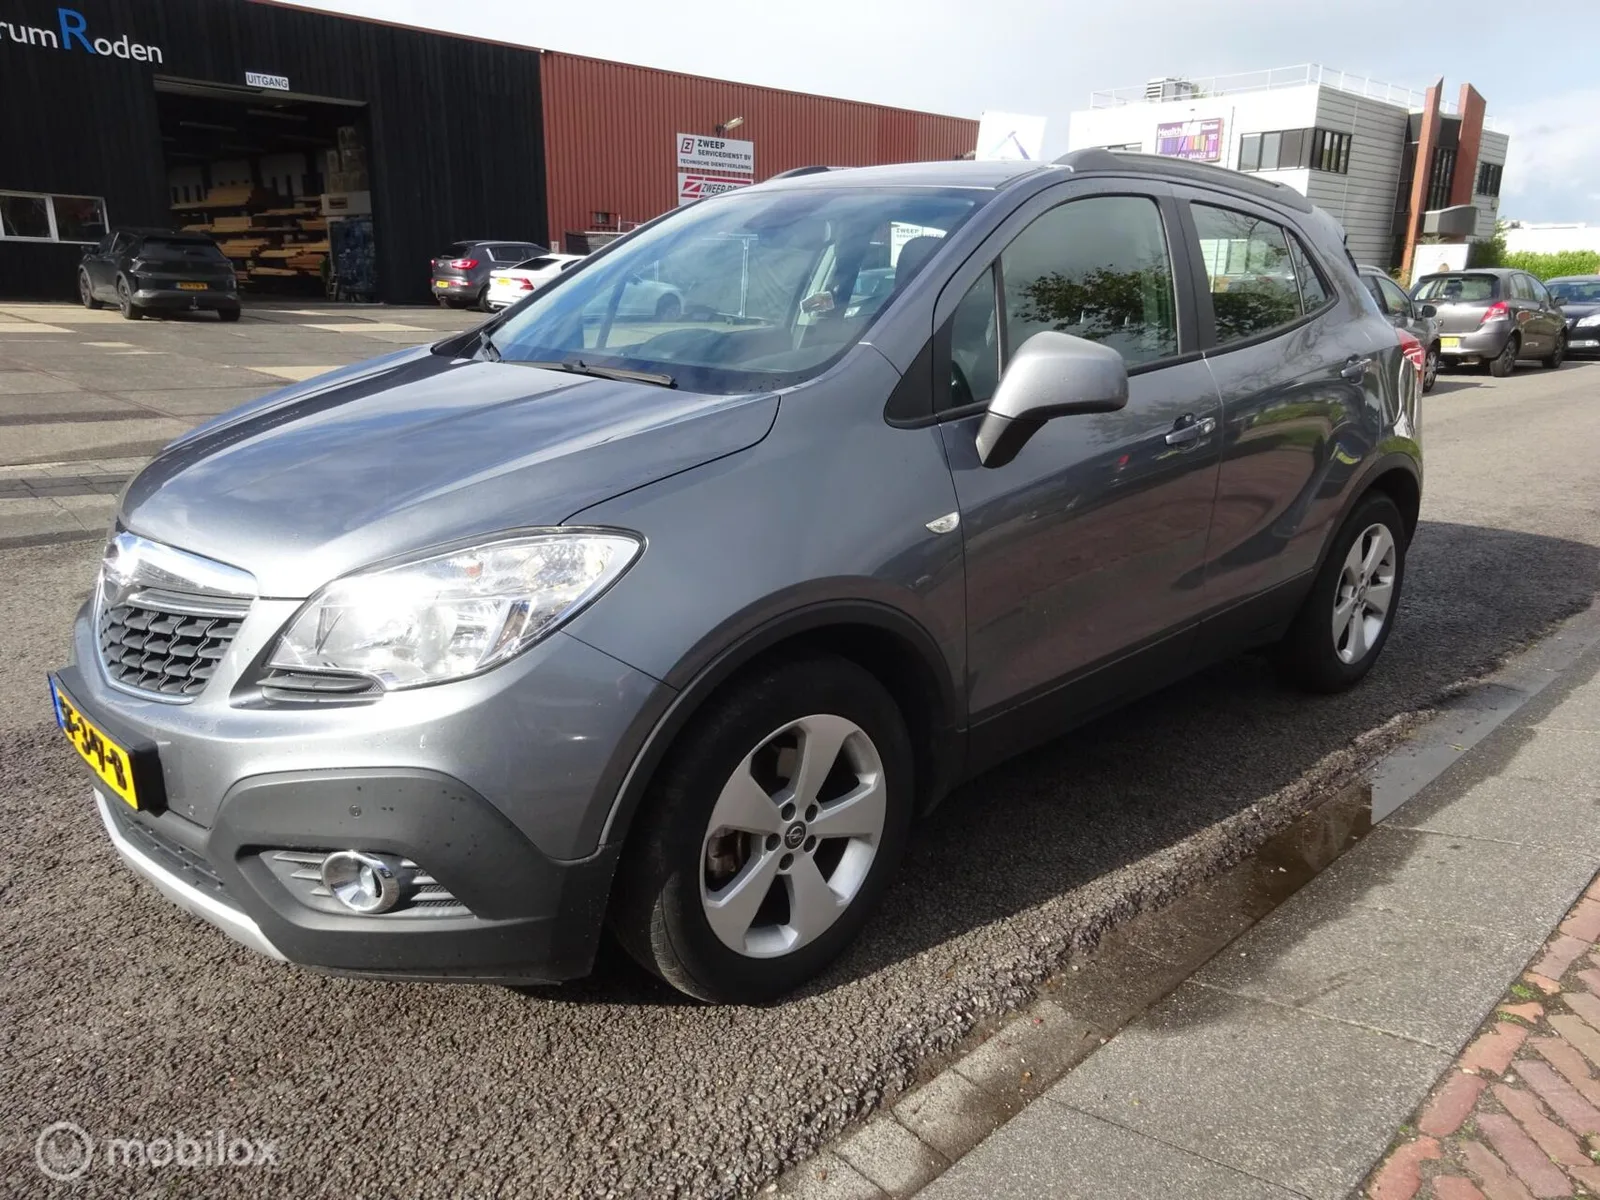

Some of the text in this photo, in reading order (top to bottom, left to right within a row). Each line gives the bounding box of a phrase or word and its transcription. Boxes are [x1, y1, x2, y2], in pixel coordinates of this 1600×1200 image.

[247, 74, 288, 88] UITGANG
[697, 139, 725, 149] ZWEEP
[698, 150, 742, 159] SERVICEDIENST
[680, 158, 709, 166] TECHNISCHE
